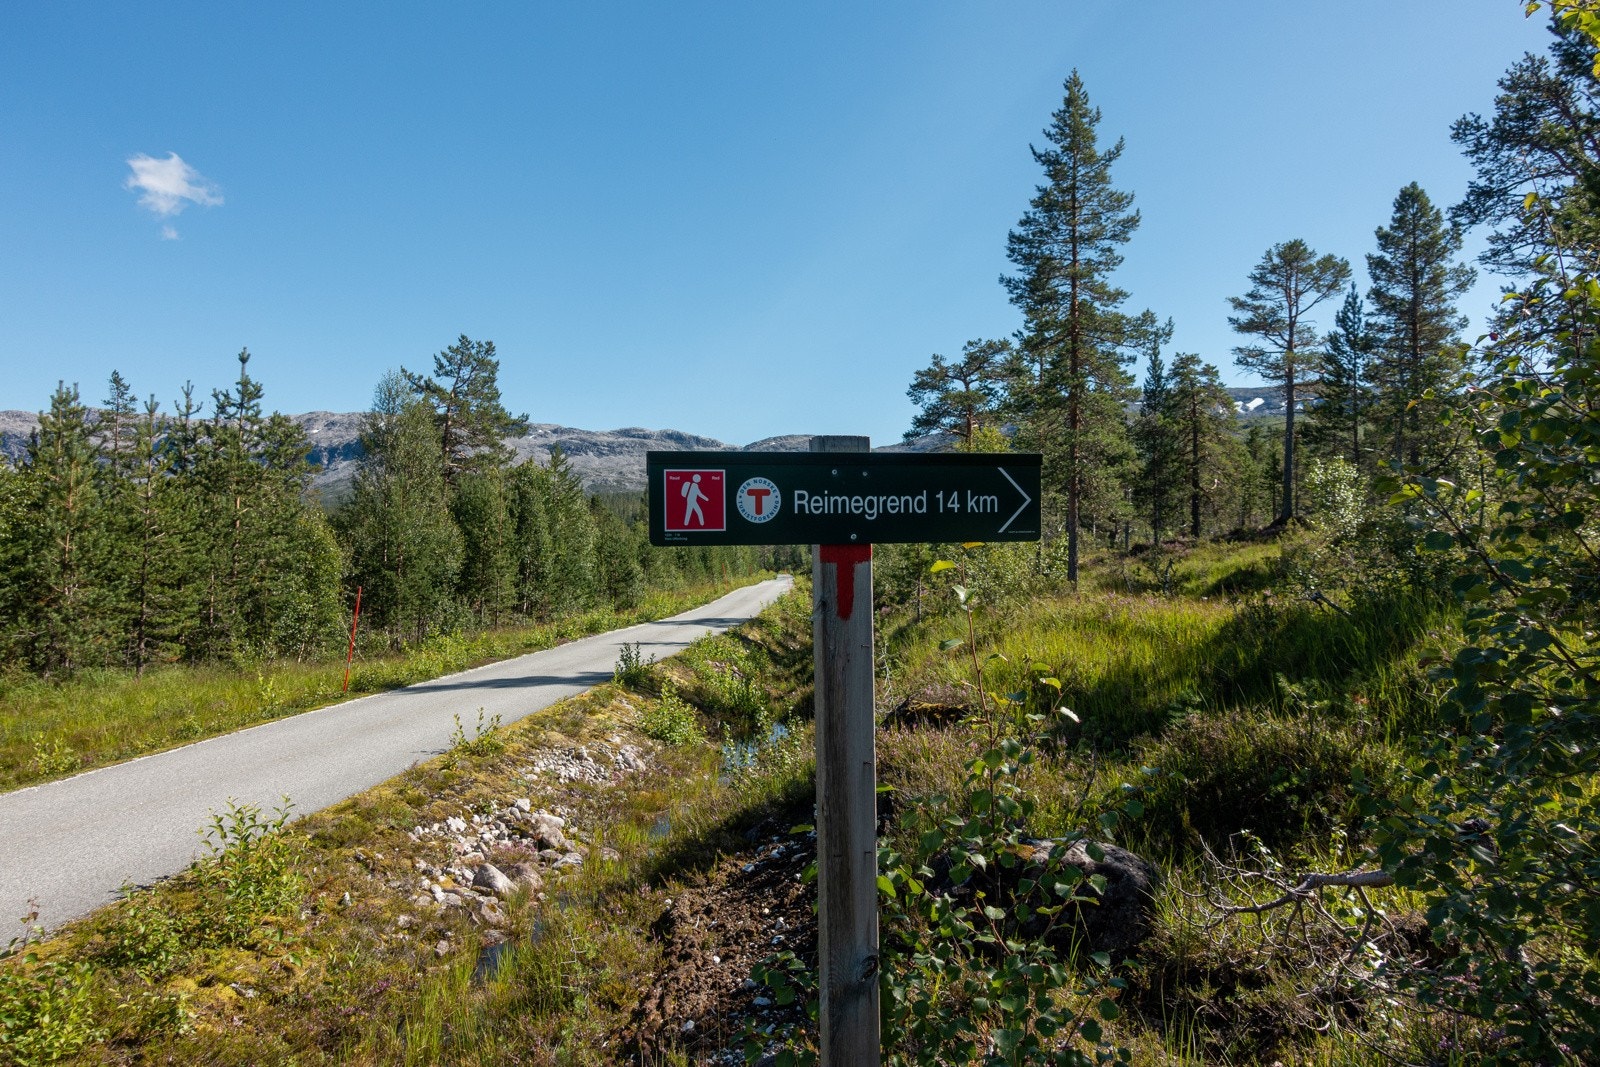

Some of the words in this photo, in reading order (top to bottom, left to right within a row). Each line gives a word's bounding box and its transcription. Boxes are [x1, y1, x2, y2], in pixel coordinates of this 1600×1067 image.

[739, 482, 751, 494] DEN
[753, 478, 778, 494] NORSKE
[738, 500, 780, 522] TURISTFORENING
[746, 488, 771, 515] T
[794, 490, 927, 520] Reimegrend
[935, 491, 960, 513] 14
[967, 490, 998, 513] km
